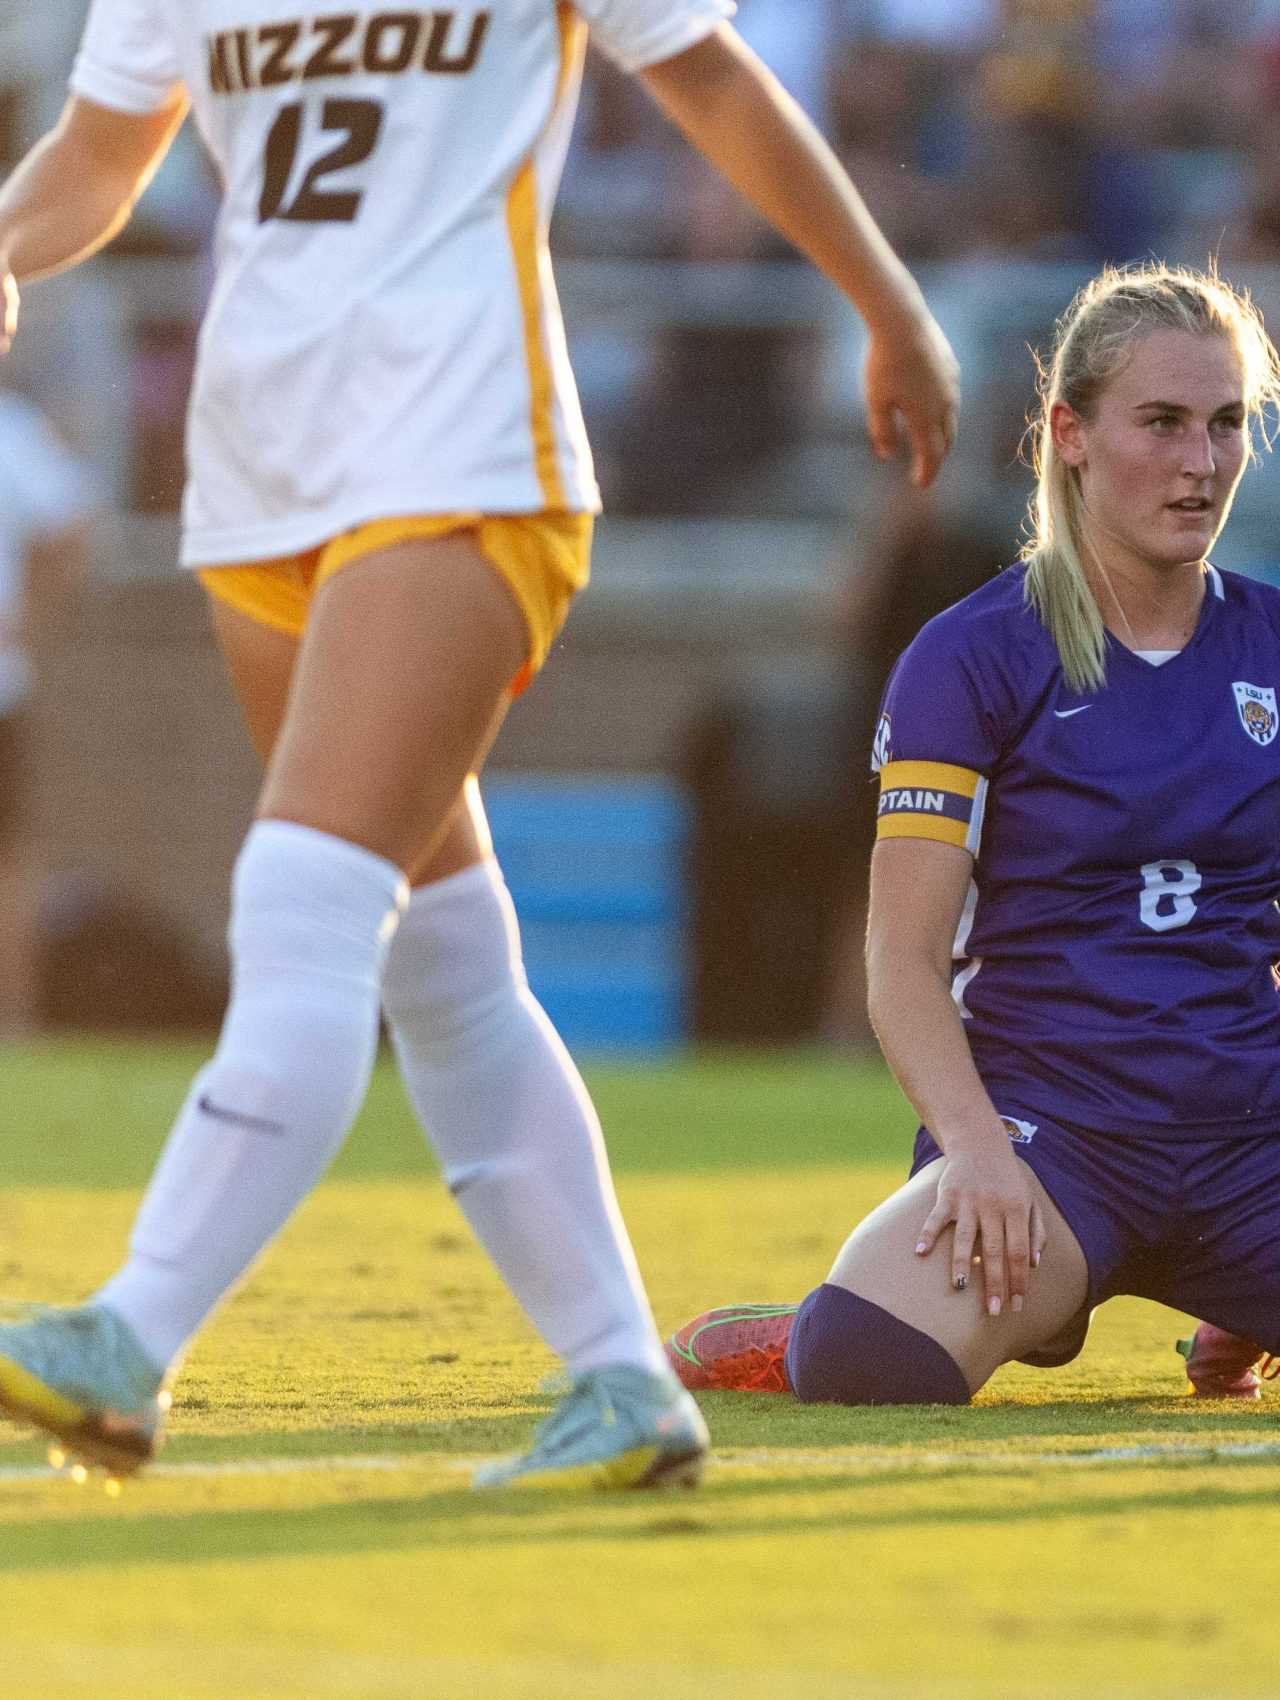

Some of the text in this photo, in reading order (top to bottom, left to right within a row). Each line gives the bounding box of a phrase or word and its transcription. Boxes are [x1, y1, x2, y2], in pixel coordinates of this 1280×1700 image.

[258, 99, 385, 225] 12
[1245, 687, 1263, 701] LSU
[1139, 859, 1203, 933] 8
